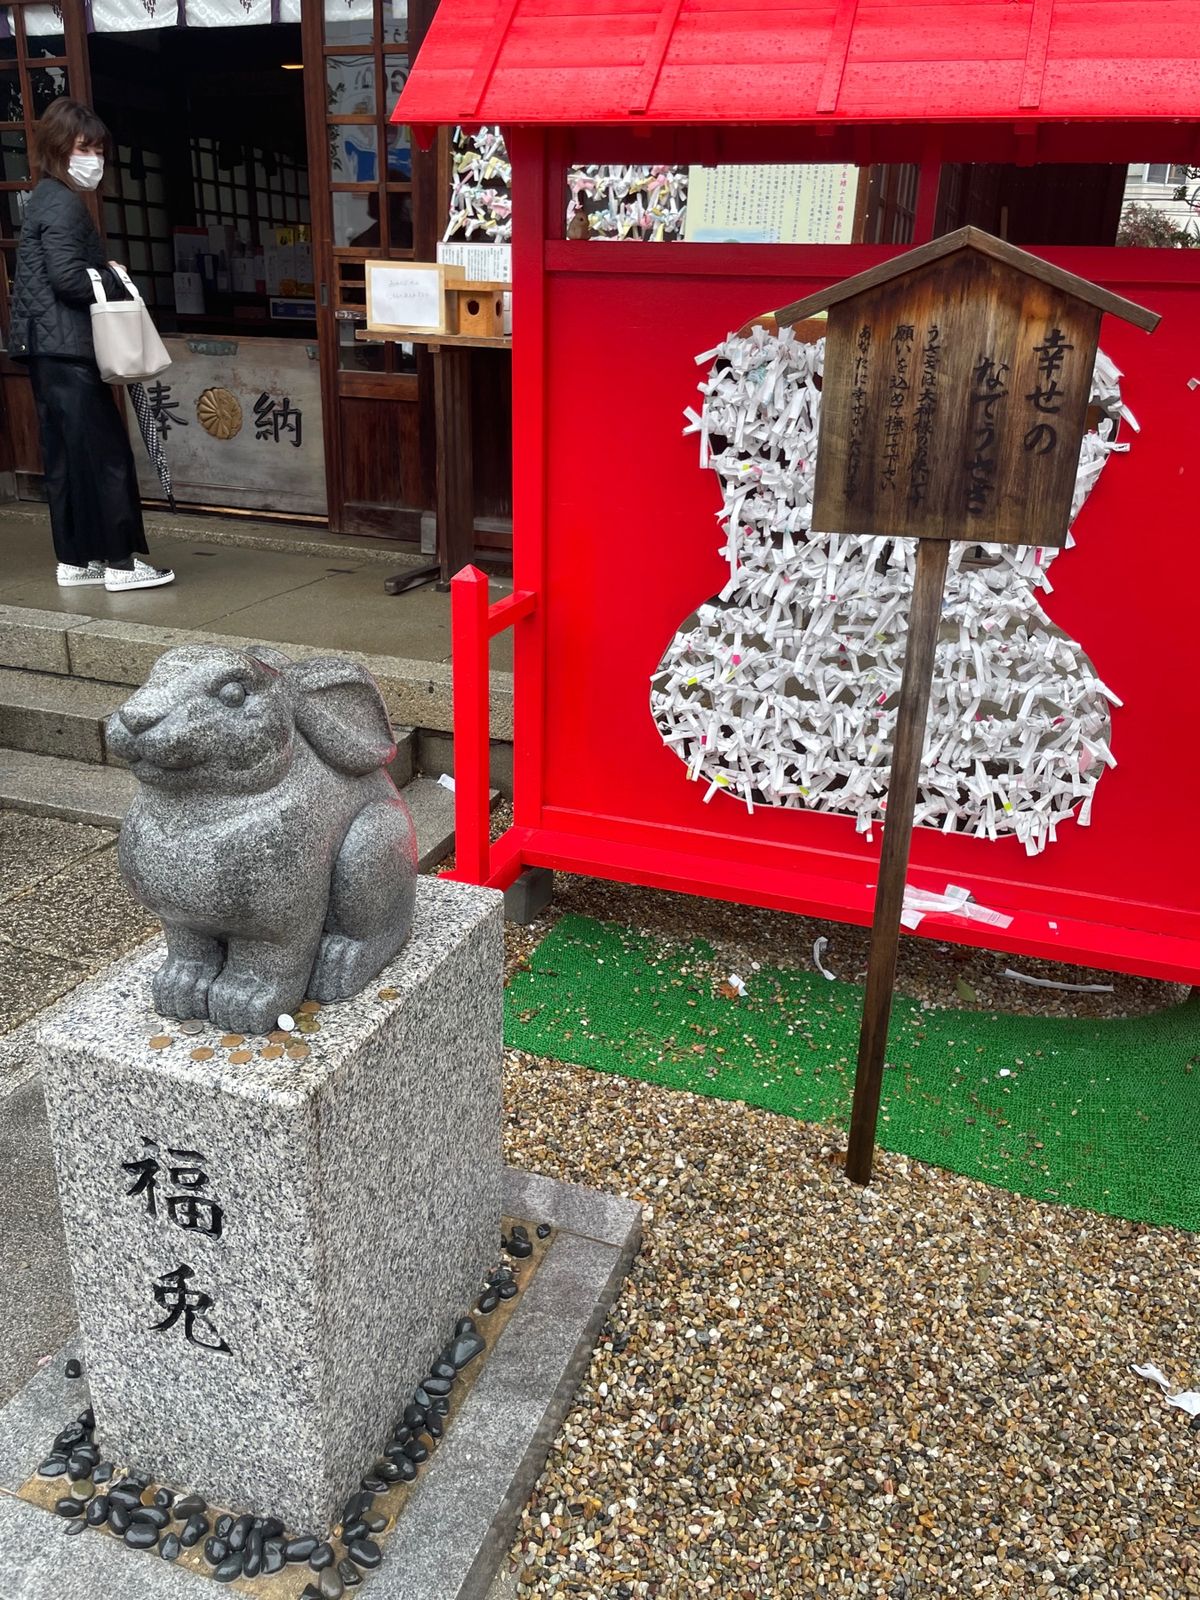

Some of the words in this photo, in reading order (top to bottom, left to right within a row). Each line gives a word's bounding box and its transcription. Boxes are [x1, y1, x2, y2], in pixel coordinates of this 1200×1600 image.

[966, 356, 1010, 515] なでうさぎ
[1023, 328, 1075, 456] 幸せの
